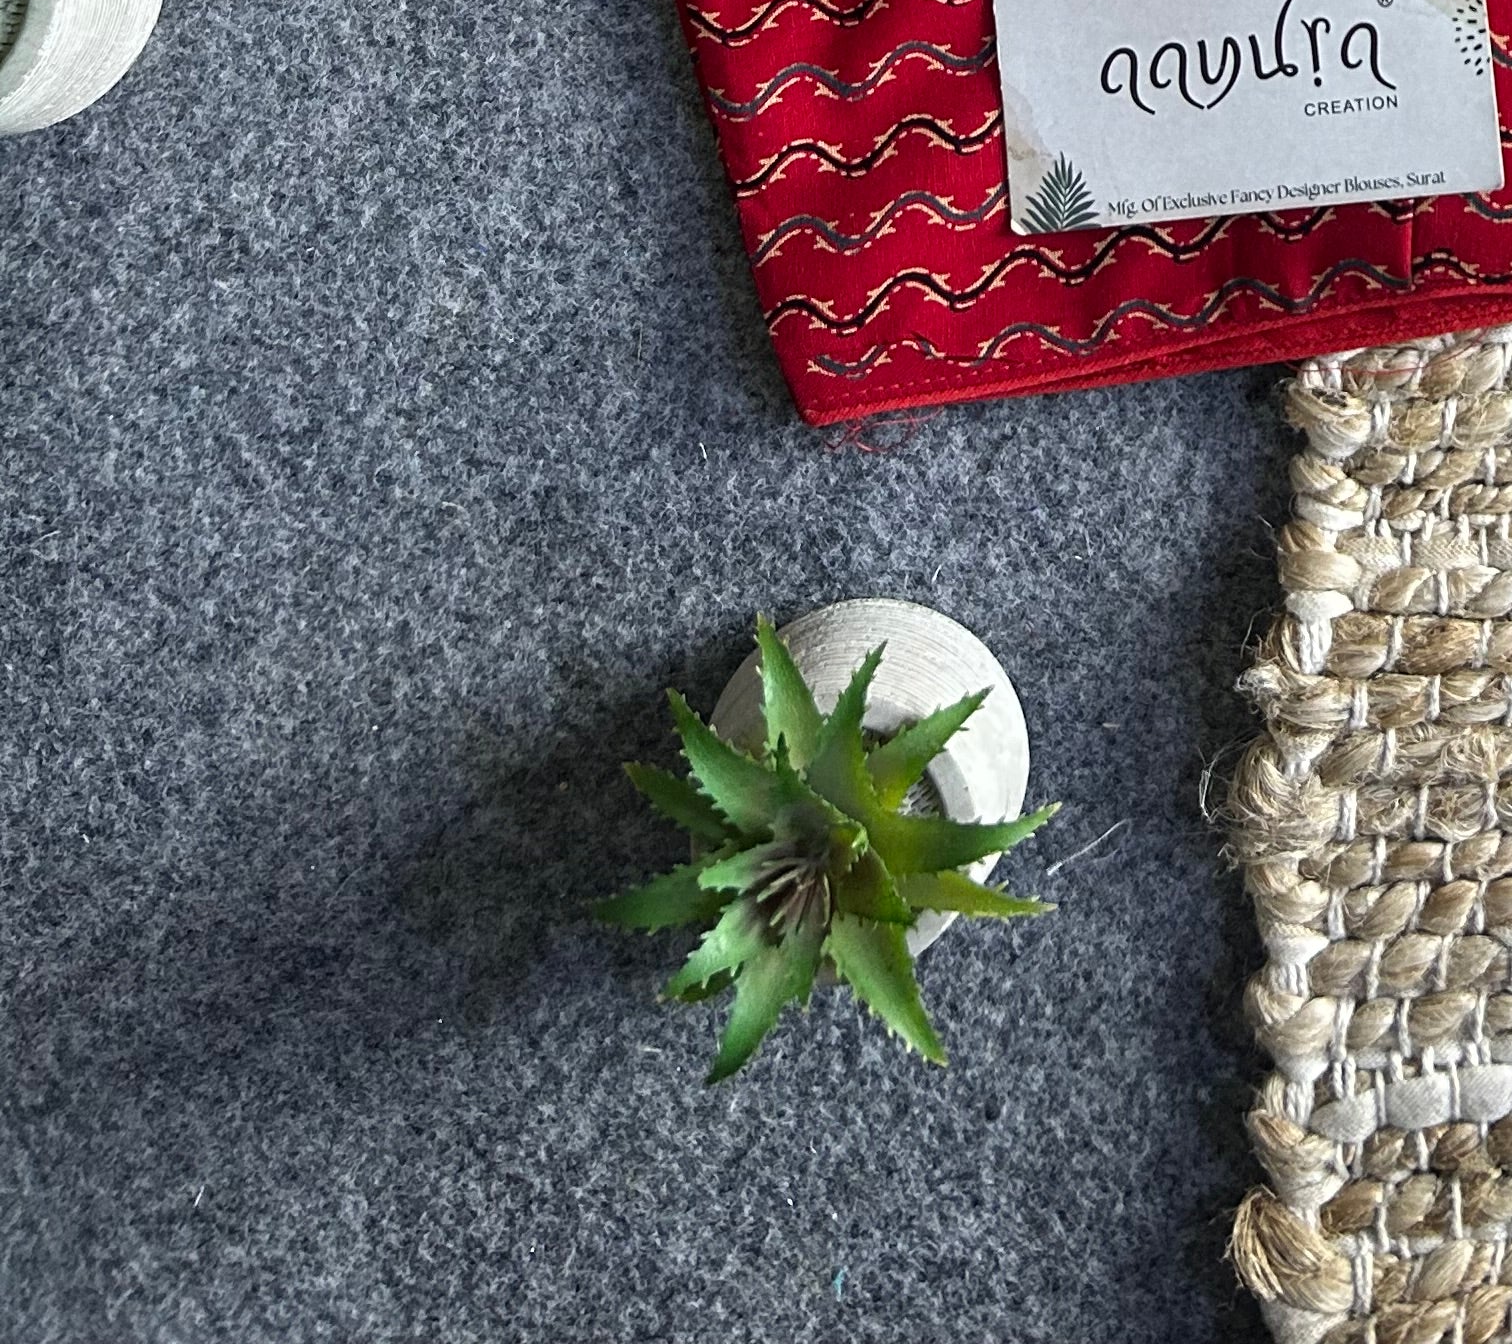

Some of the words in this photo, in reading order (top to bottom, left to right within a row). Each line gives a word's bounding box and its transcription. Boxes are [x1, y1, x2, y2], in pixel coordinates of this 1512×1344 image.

[1304, 95, 1399, 116] CREATION
[1108, 198, 1138, 219] Mfg.
[1141, 195, 1162, 212] Of
[1163, 192, 1228, 211] Exclusive
[1230, 185, 1275, 204] Fancy
[1277, 182, 1342, 201] Designer
[1344, 176, 1405, 194] Blouses,
[1406, 171, 1447, 187] Surat
